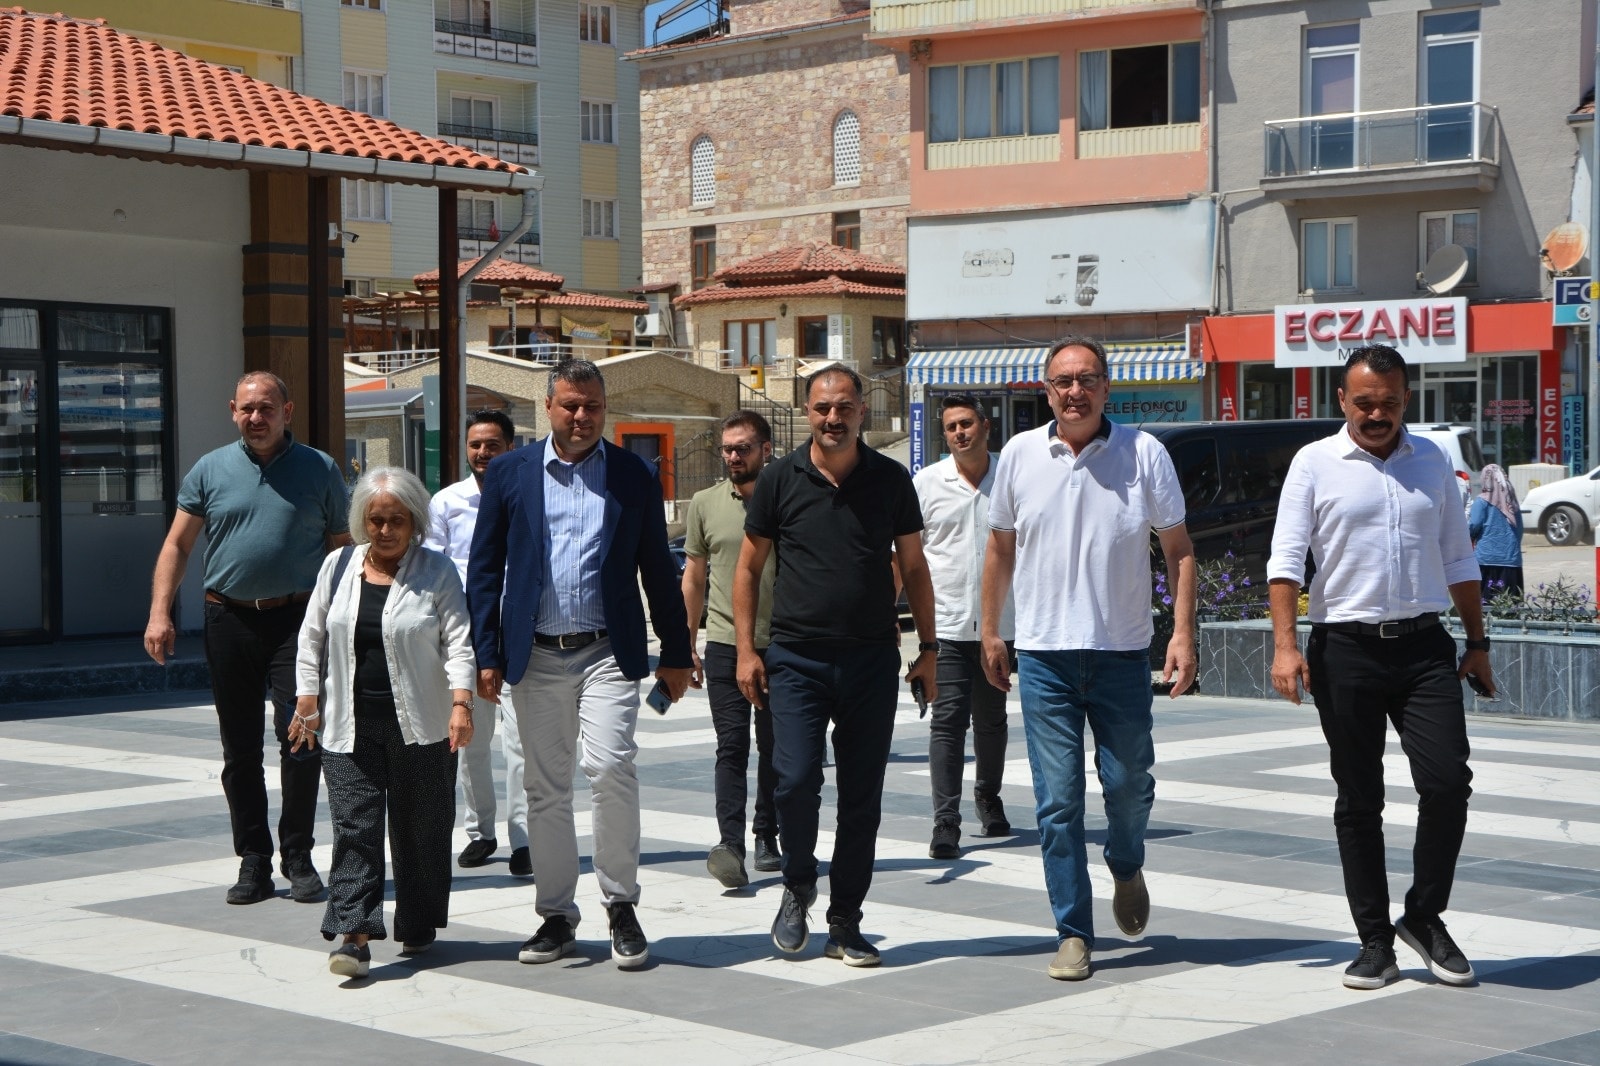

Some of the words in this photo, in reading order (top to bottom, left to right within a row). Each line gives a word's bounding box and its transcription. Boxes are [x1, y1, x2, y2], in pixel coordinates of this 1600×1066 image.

[1284, 304, 1456, 344] ECZANE
[1103, 400, 1187, 414] ELEFONCU
[1543, 388, 1557, 464] ECZAN
[1573, 402, 1582, 474] BERBER
[913, 410, 921, 475] TELEFO
